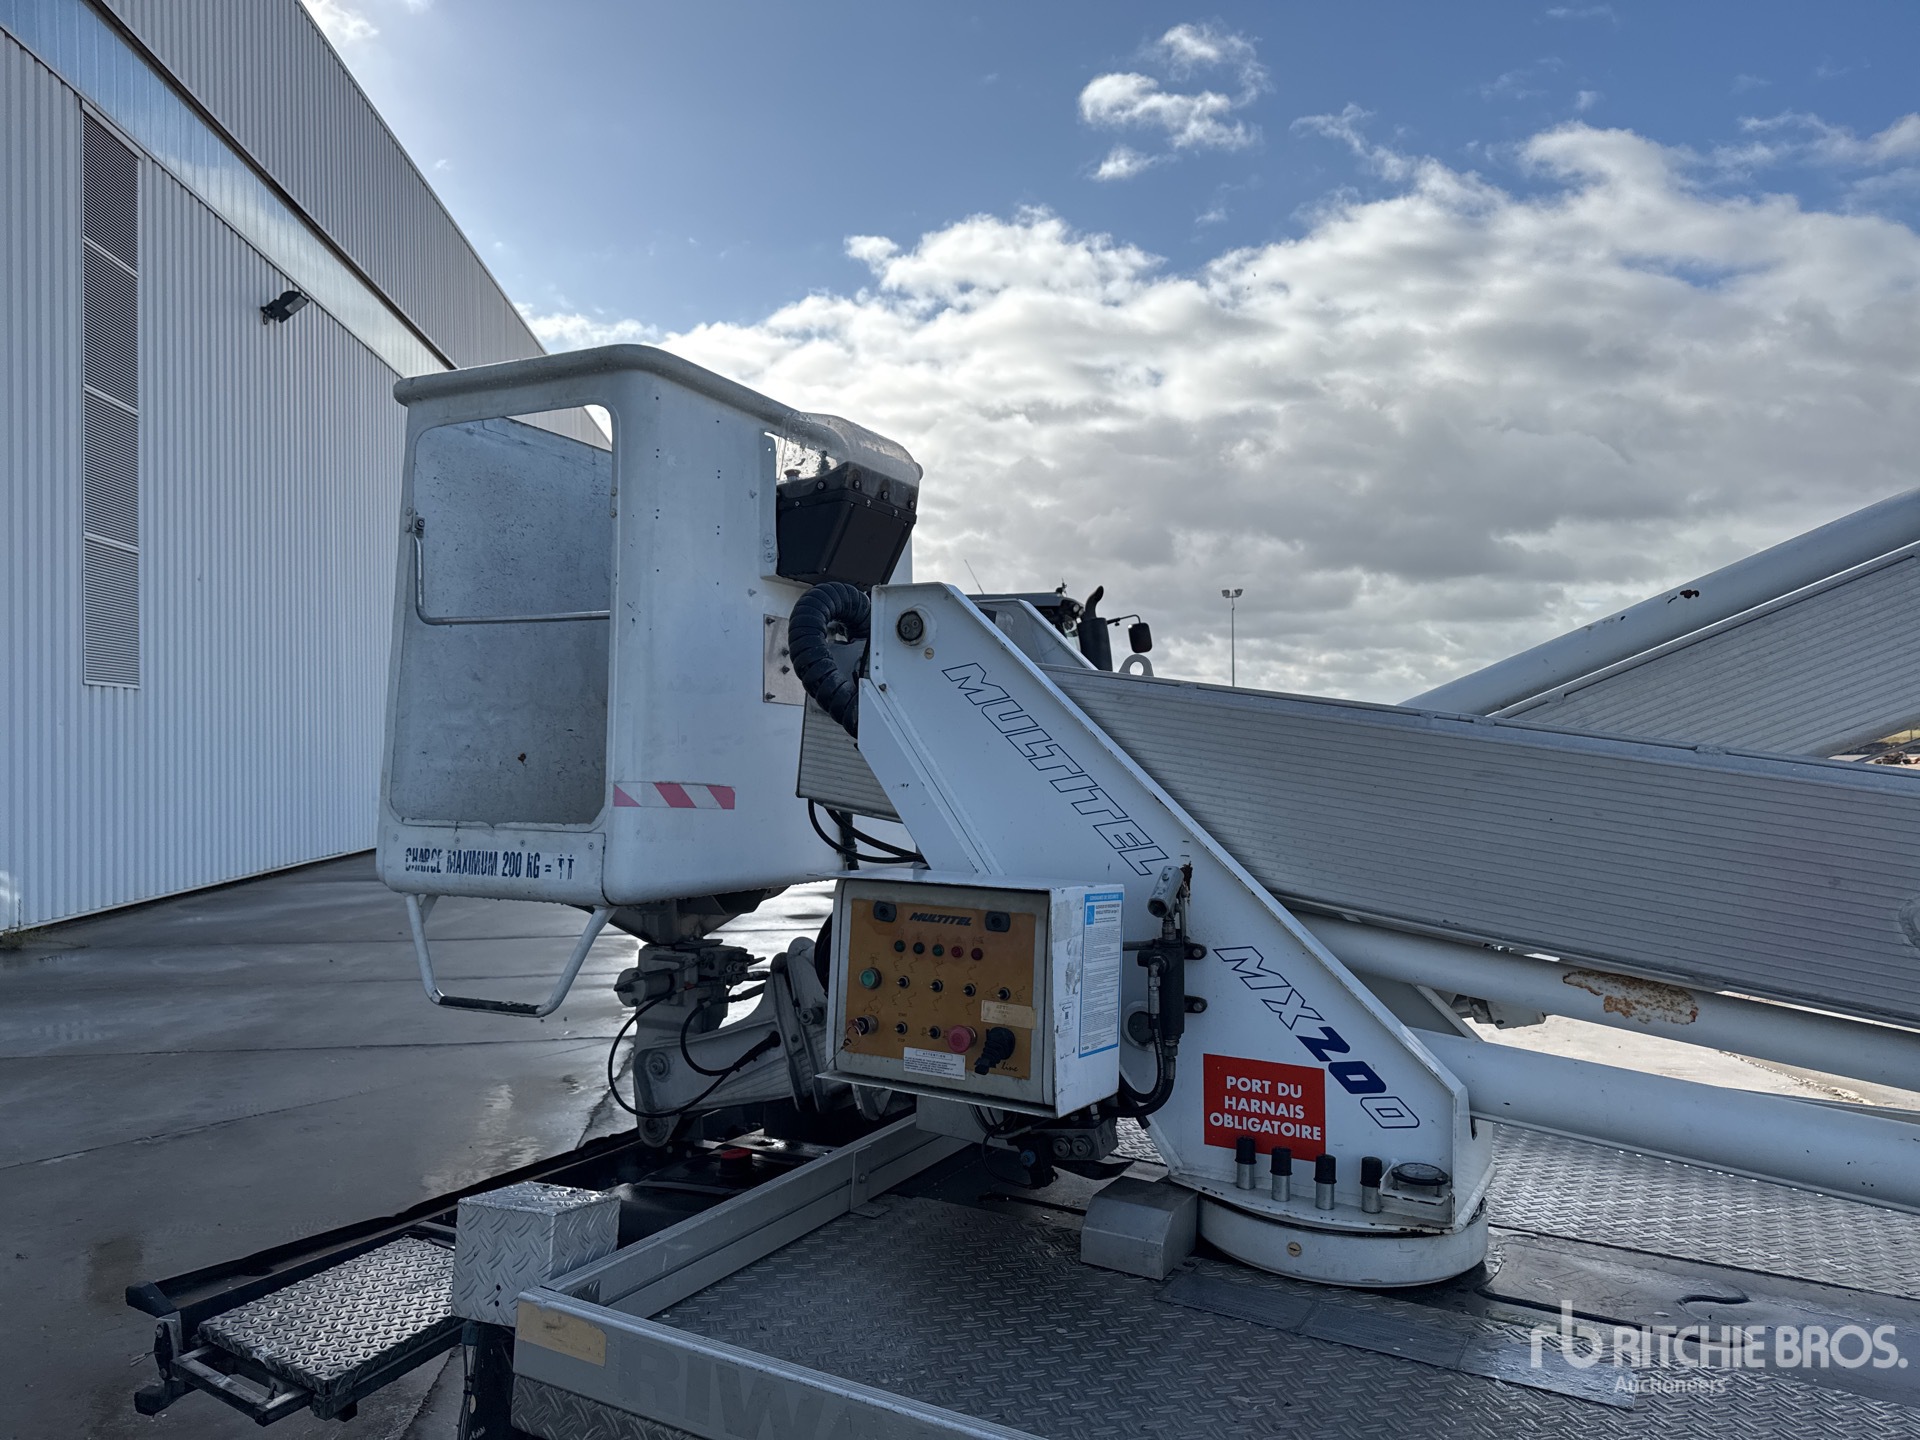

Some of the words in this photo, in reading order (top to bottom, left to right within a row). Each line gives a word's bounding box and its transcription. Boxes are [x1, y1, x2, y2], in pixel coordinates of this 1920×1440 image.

[941, 662, 1170, 876] MULTITEL
[446, 849, 499, 877] MAXIMUM
[501, 851, 522, 878] 200
[526, 852, 541, 879] KG
[908, 911, 973, 927] MULTITEL
[1226, 1075, 1271, 1095] PORT
[1277, 1081, 1303, 1099] DU
[1224, 1095, 1305, 1119] HARNAIS
[1209, 1112, 1322, 1141] OBLIGATOIRE
